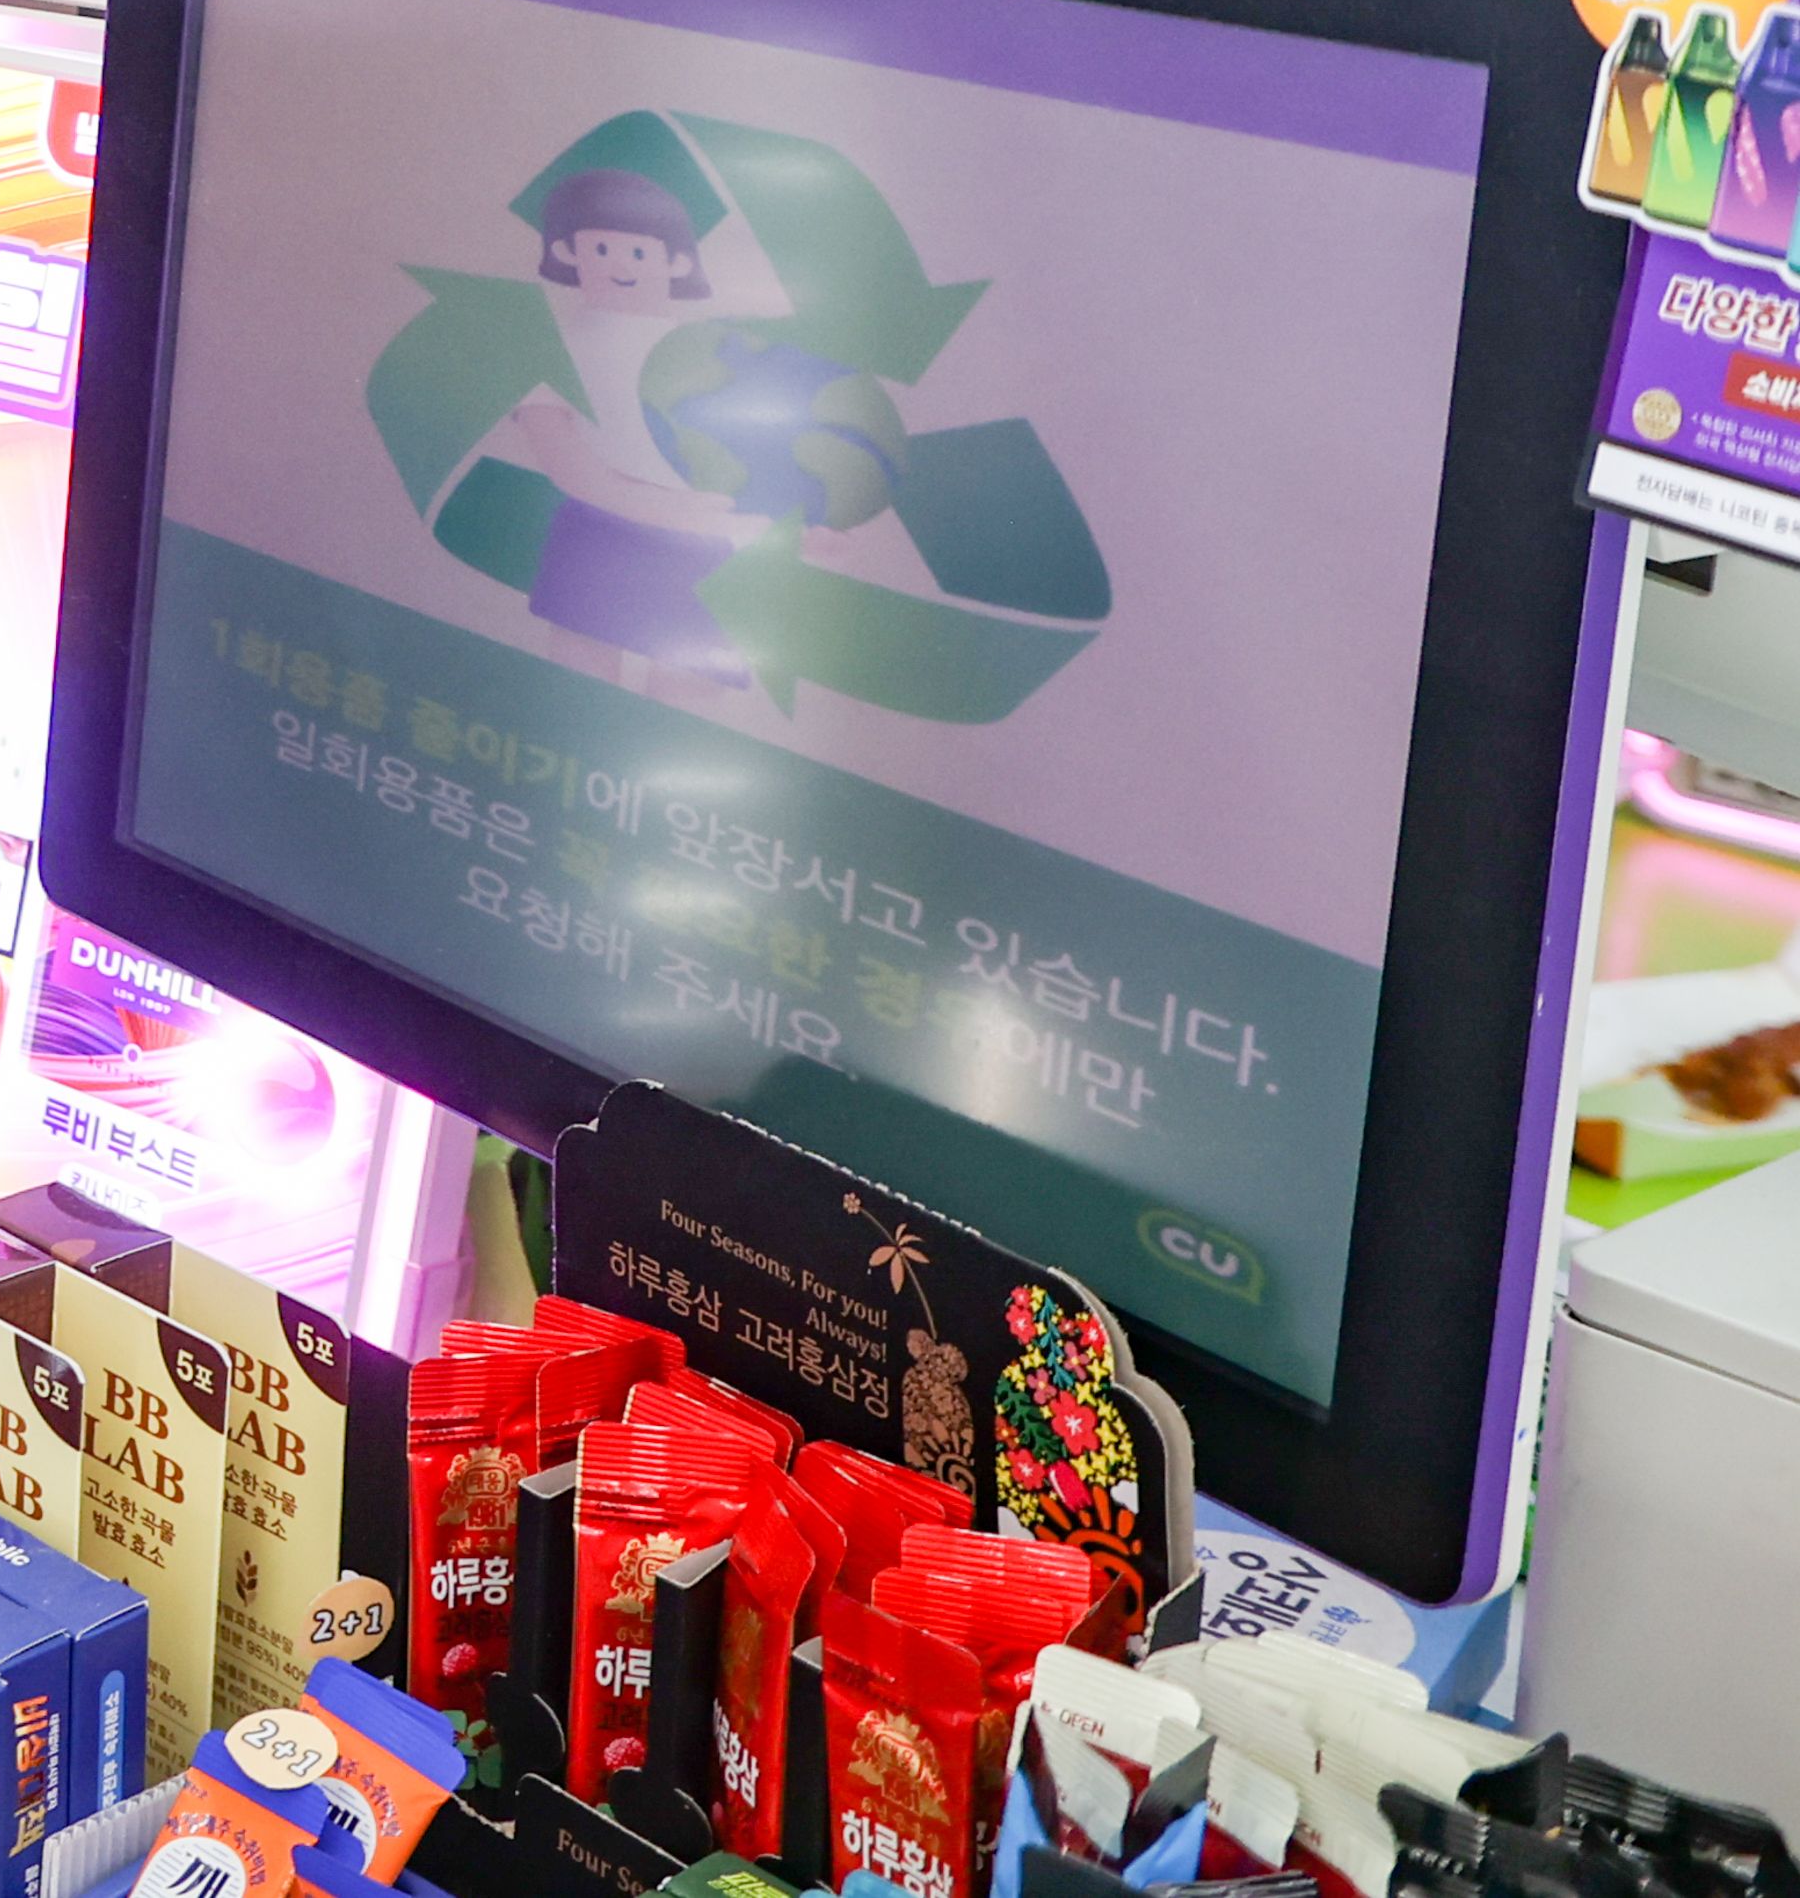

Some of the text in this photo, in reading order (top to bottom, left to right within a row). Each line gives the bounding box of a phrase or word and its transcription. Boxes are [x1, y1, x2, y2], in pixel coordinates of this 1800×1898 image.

[1659, 273, 1798, 356] 다양한
[272, 709, 536, 862] 일회용품은
[461, 865, 633, 981] 요청해
[665, 802, 926, 946] 앞장서고
[956, 917, 1279, 1095] 있습니다.
[70, 936, 222, 1015] DUNHILL
[42, 1097, 198, 1189] 루비 부스트
[661, 1199, 888, 1330] Four Seasons, For you!
[1159, 1225, 1239, 1279] CU
[296, 1321, 334, 1367] 5포
[609, 1241, 890, 1419] 하루홍삼 고려홍삼정
[806, 1307, 887, 1363] Always!
[33, 1365, 70, 1410] 5포
[176, 1348, 214, 1395] 5포
[102, 1368, 169, 1440] BB
[85, 1413, 185, 1505] LAB
[84, 1475, 176, 1546] 고소한 곡물
[251, 1506, 288, 1542] 효소
[261, 1479, 298, 1518] 곡물
[92, 1508, 165, 1568] 발효 효소
[430, 1557, 514, 1609] 하루홍
[311, 1604, 384, 1644] 2+1
[243, 1718, 322, 1777] 2+1
[1060, 1708, 1105, 1737] OPEN
[9, 1695, 48, 1858] 비상대책
[557, 1828, 612, 1878] Four
